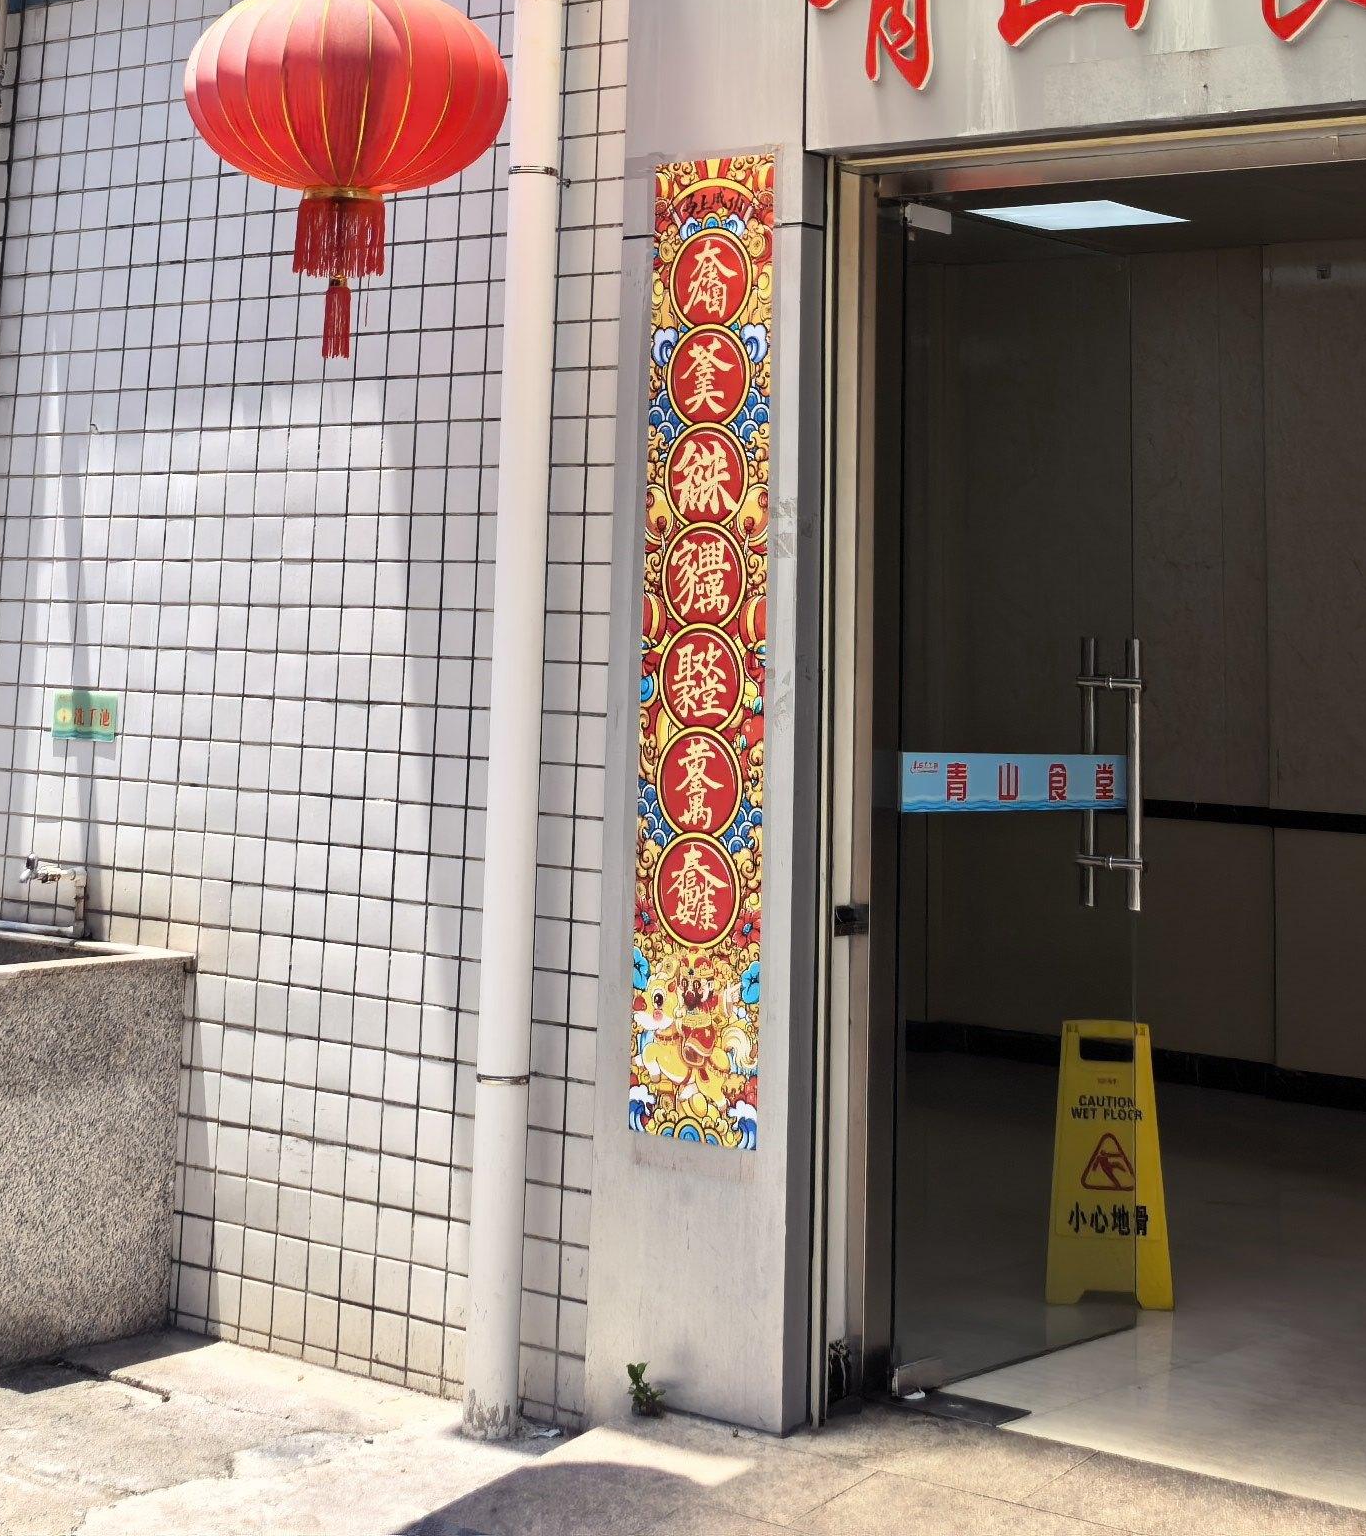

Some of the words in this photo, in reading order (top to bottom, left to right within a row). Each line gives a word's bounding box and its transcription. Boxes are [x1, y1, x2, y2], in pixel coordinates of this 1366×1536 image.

[946, 762, 1115, 802] 青山食堂
[1078, 1094, 1135, 1109] CAUTION
[1071, 1107, 1097, 1119] WET
